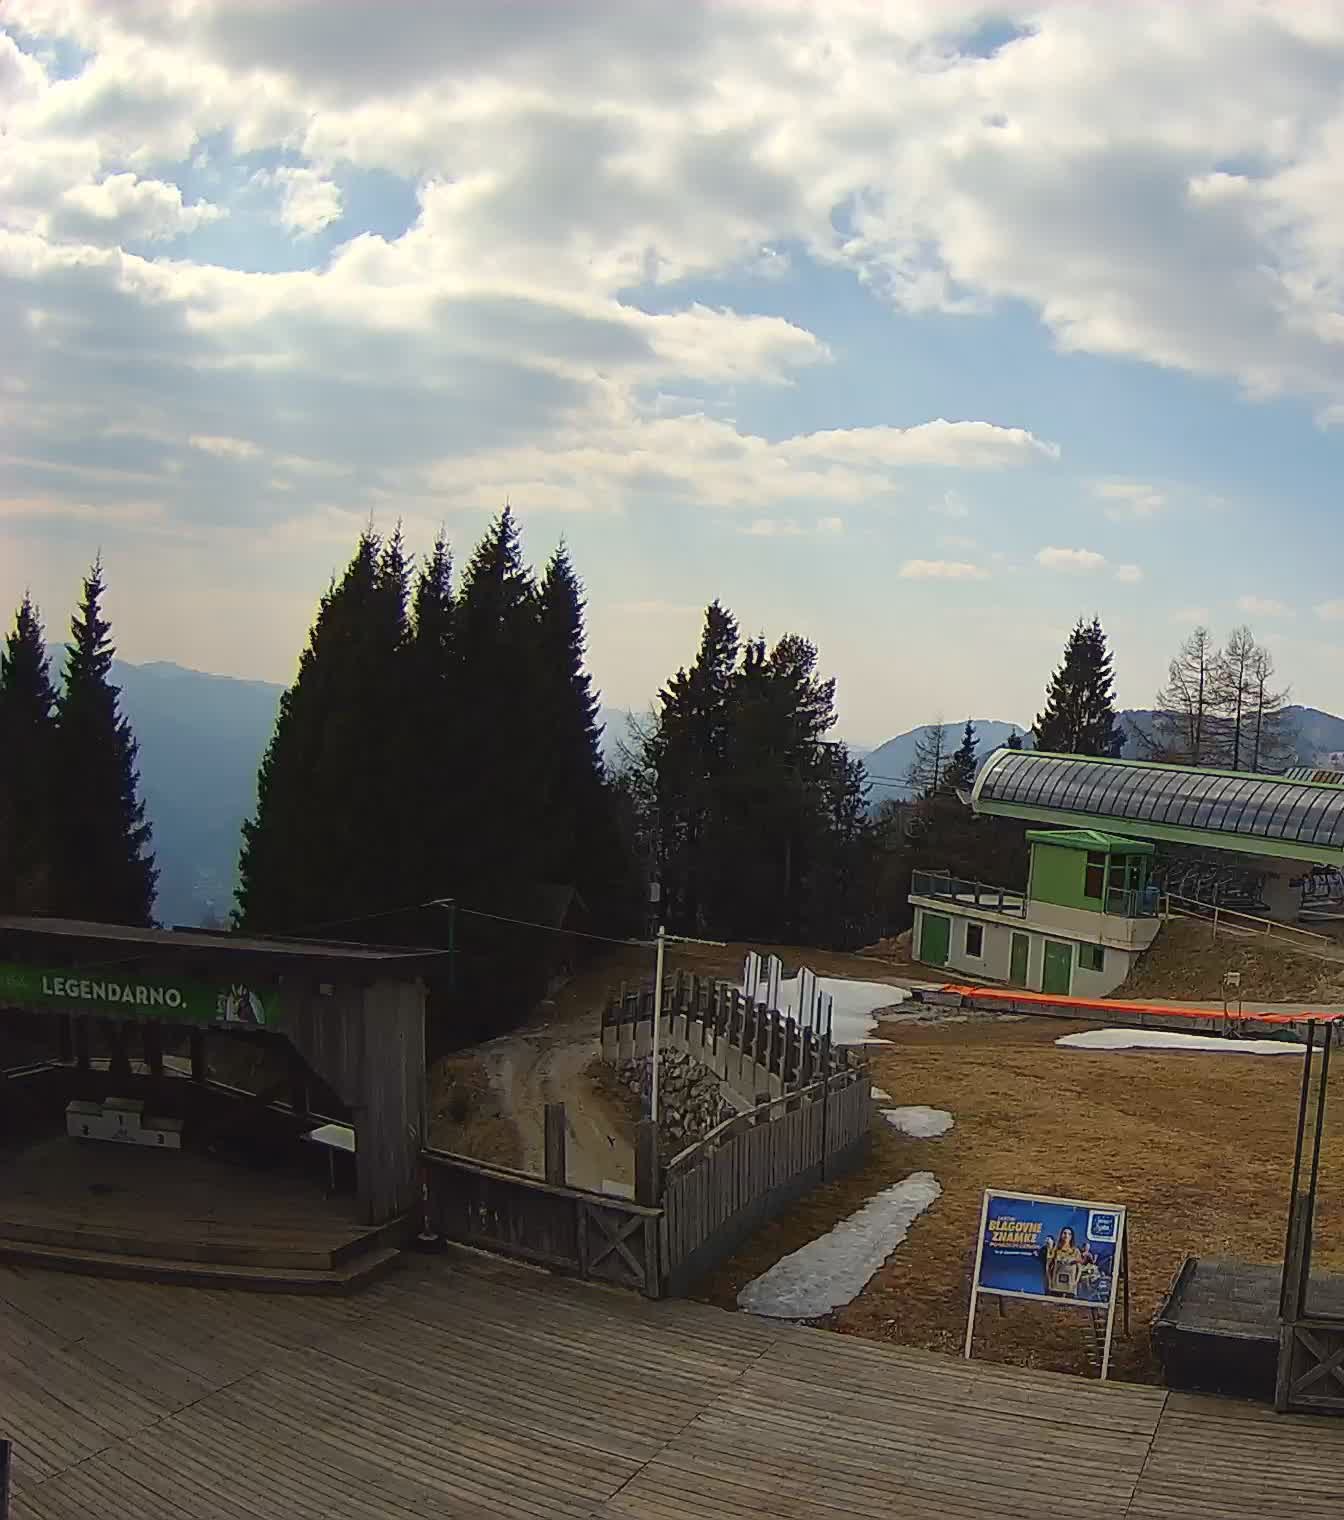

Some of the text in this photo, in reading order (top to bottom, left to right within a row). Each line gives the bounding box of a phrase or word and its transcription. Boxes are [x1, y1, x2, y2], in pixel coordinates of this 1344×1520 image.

[41, 976, 188, 1010] LEGENDARNO.
[988, 1219, 1042, 1233] BLAGOVNE
[992, 1231, 1038, 1244] ZNAMKE
